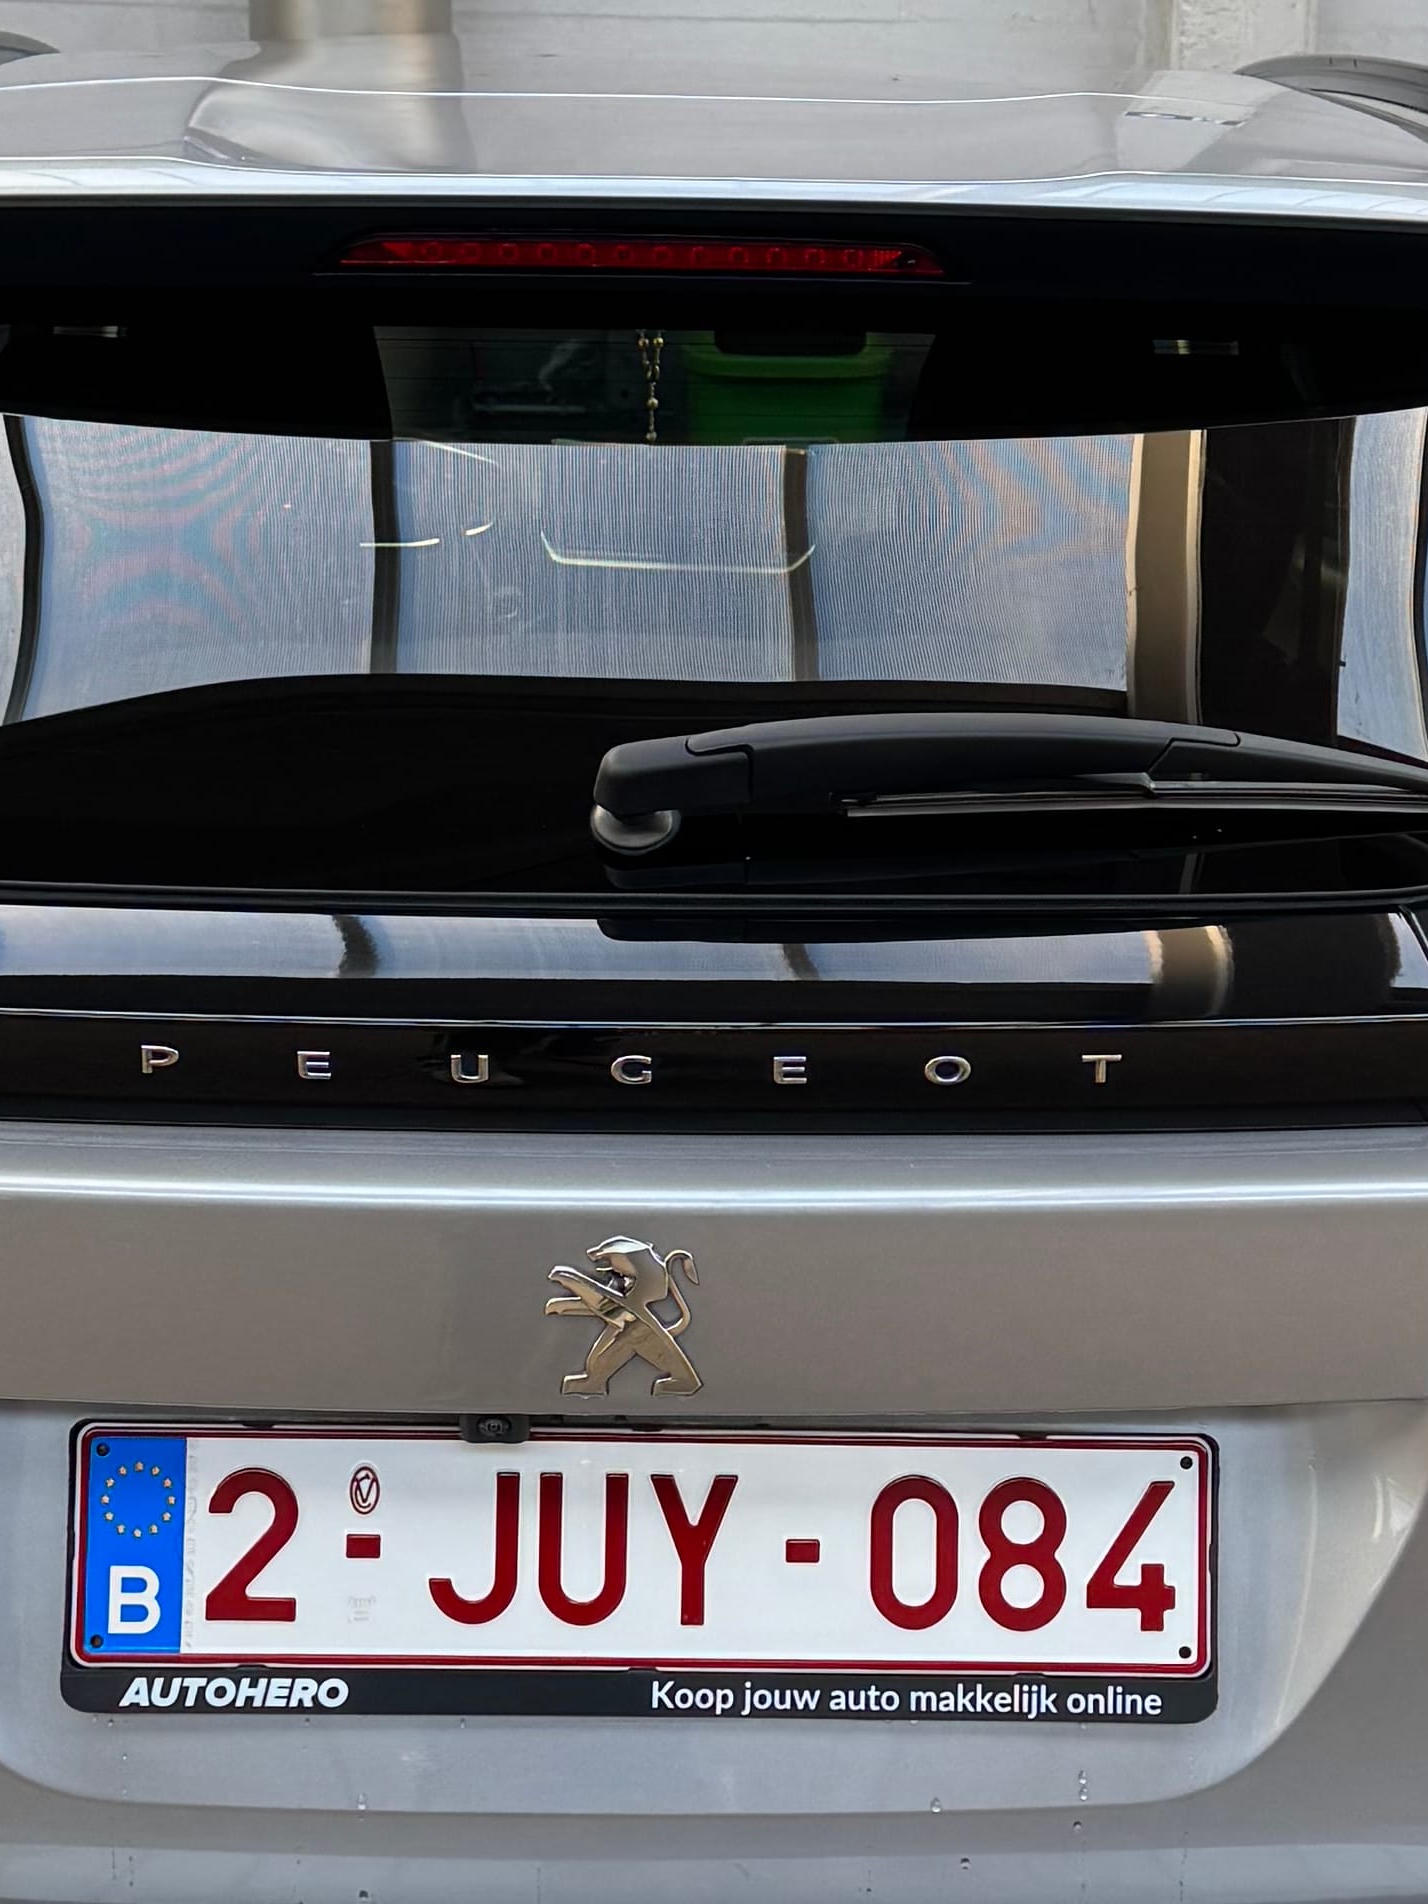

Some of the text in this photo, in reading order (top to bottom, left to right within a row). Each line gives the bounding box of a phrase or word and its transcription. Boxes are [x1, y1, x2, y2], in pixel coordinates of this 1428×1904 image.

[140, 1044, 1123, 1086] PEUGEOT
[107, 1564, 162, 1635] B
[118, 1676, 350, 1709] AUTOHERO
[651, 1680, 1163, 1720] Koop jouw auto makkelijk online
